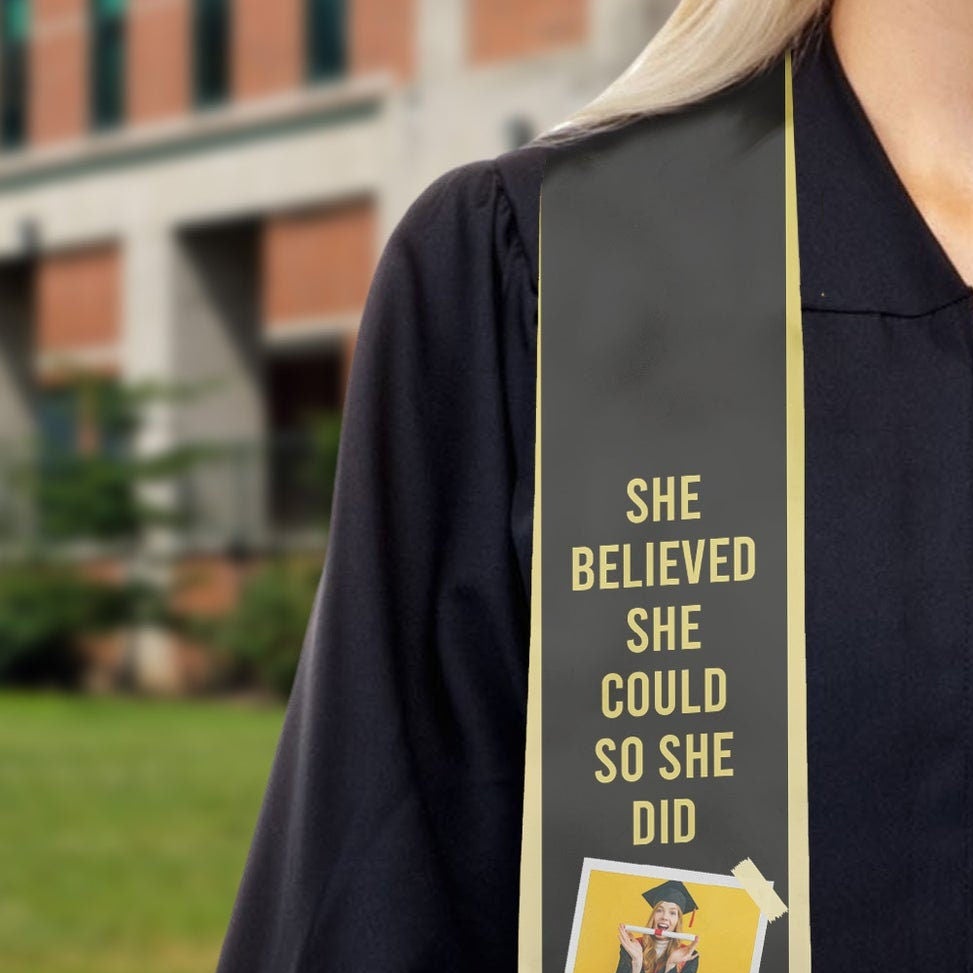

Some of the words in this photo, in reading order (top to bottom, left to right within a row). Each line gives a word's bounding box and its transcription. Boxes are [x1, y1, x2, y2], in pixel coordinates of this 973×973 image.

[625, 474, 702, 525] SHE
[571, 535, 756, 592] BELIEVED
[626, 604, 702, 654] SHE
[601, 667, 727, 719] COULD
[594, 735, 644, 784] SO
[658, 730, 735, 781] SHE
[632, 797, 696, 846] DID
